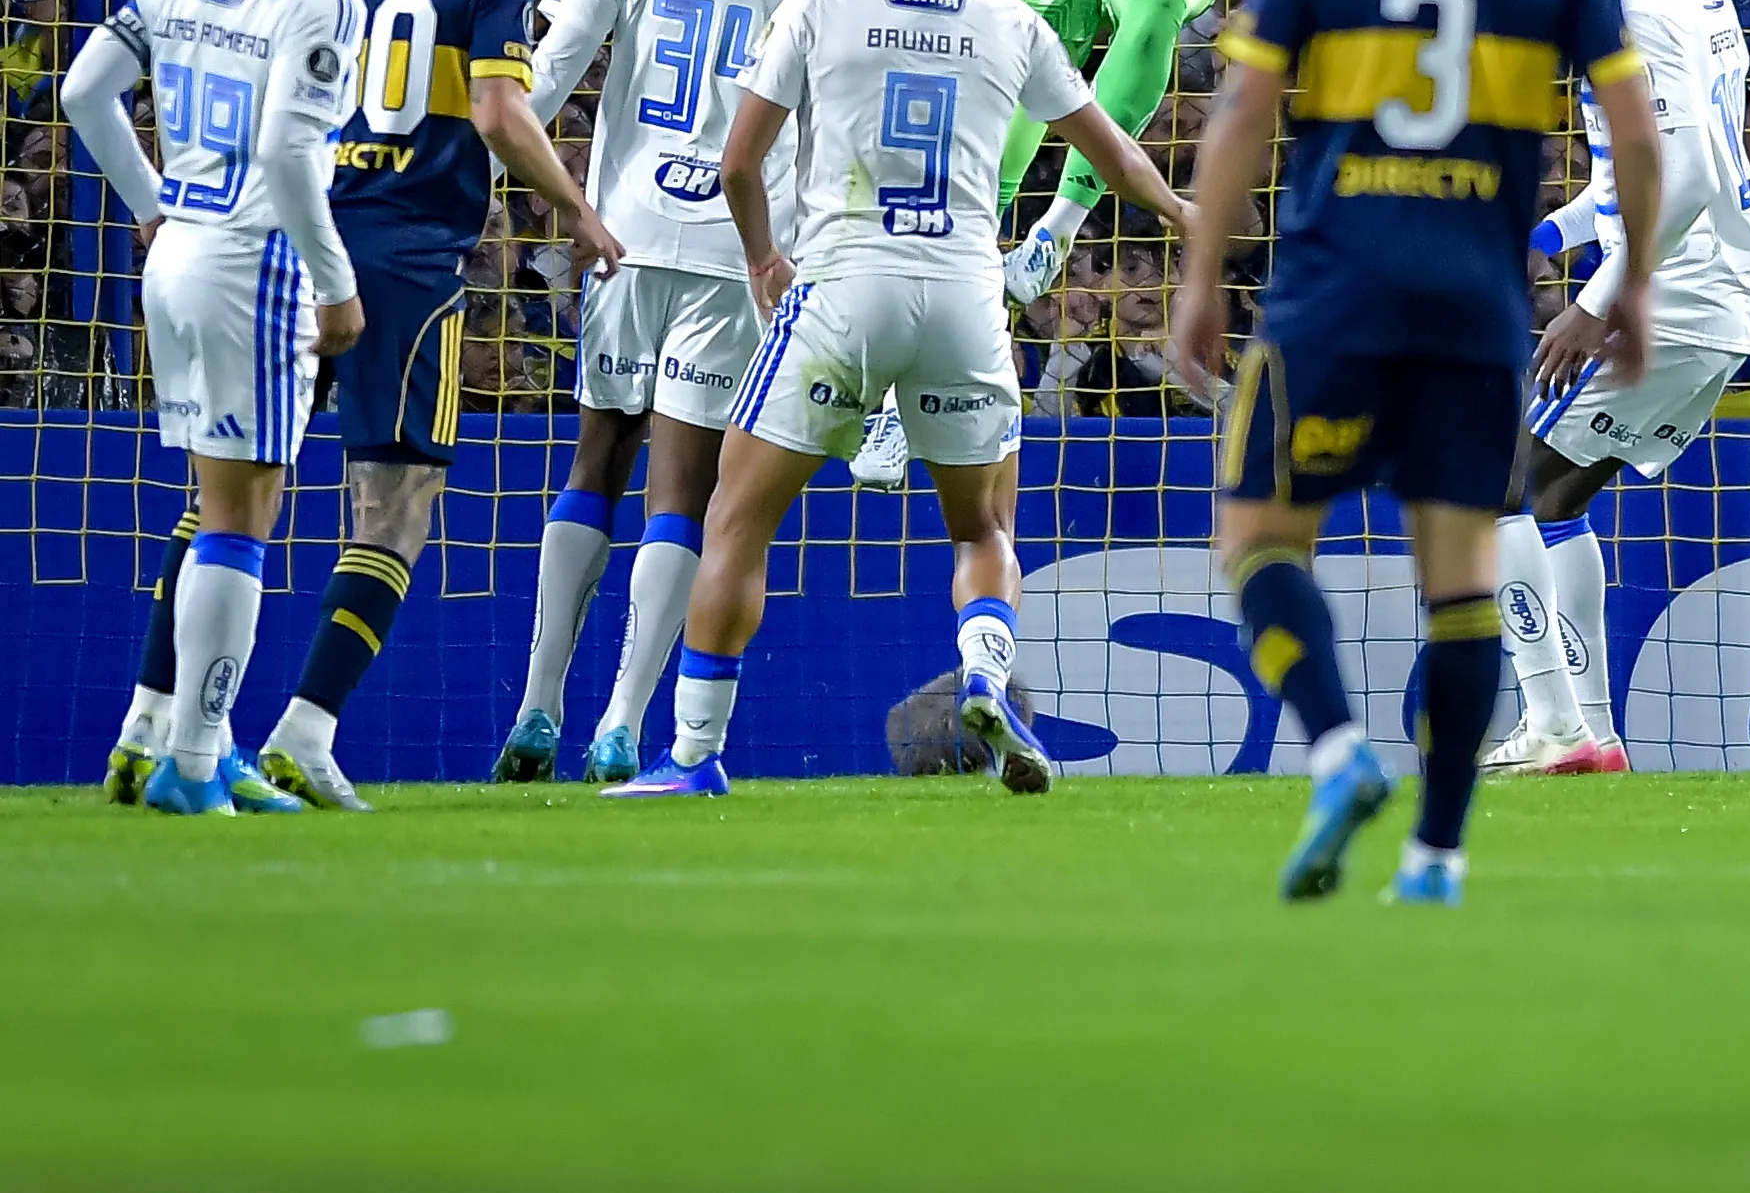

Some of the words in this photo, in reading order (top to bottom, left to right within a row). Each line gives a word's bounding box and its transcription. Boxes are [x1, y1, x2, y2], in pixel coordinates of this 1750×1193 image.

[866, 28, 951, 53] BRUNO
[878, 71, 957, 208] 9
[662, 162, 718, 195] BH
[893, 208, 947, 234] BH
[680, 363, 734, 390] álamo
